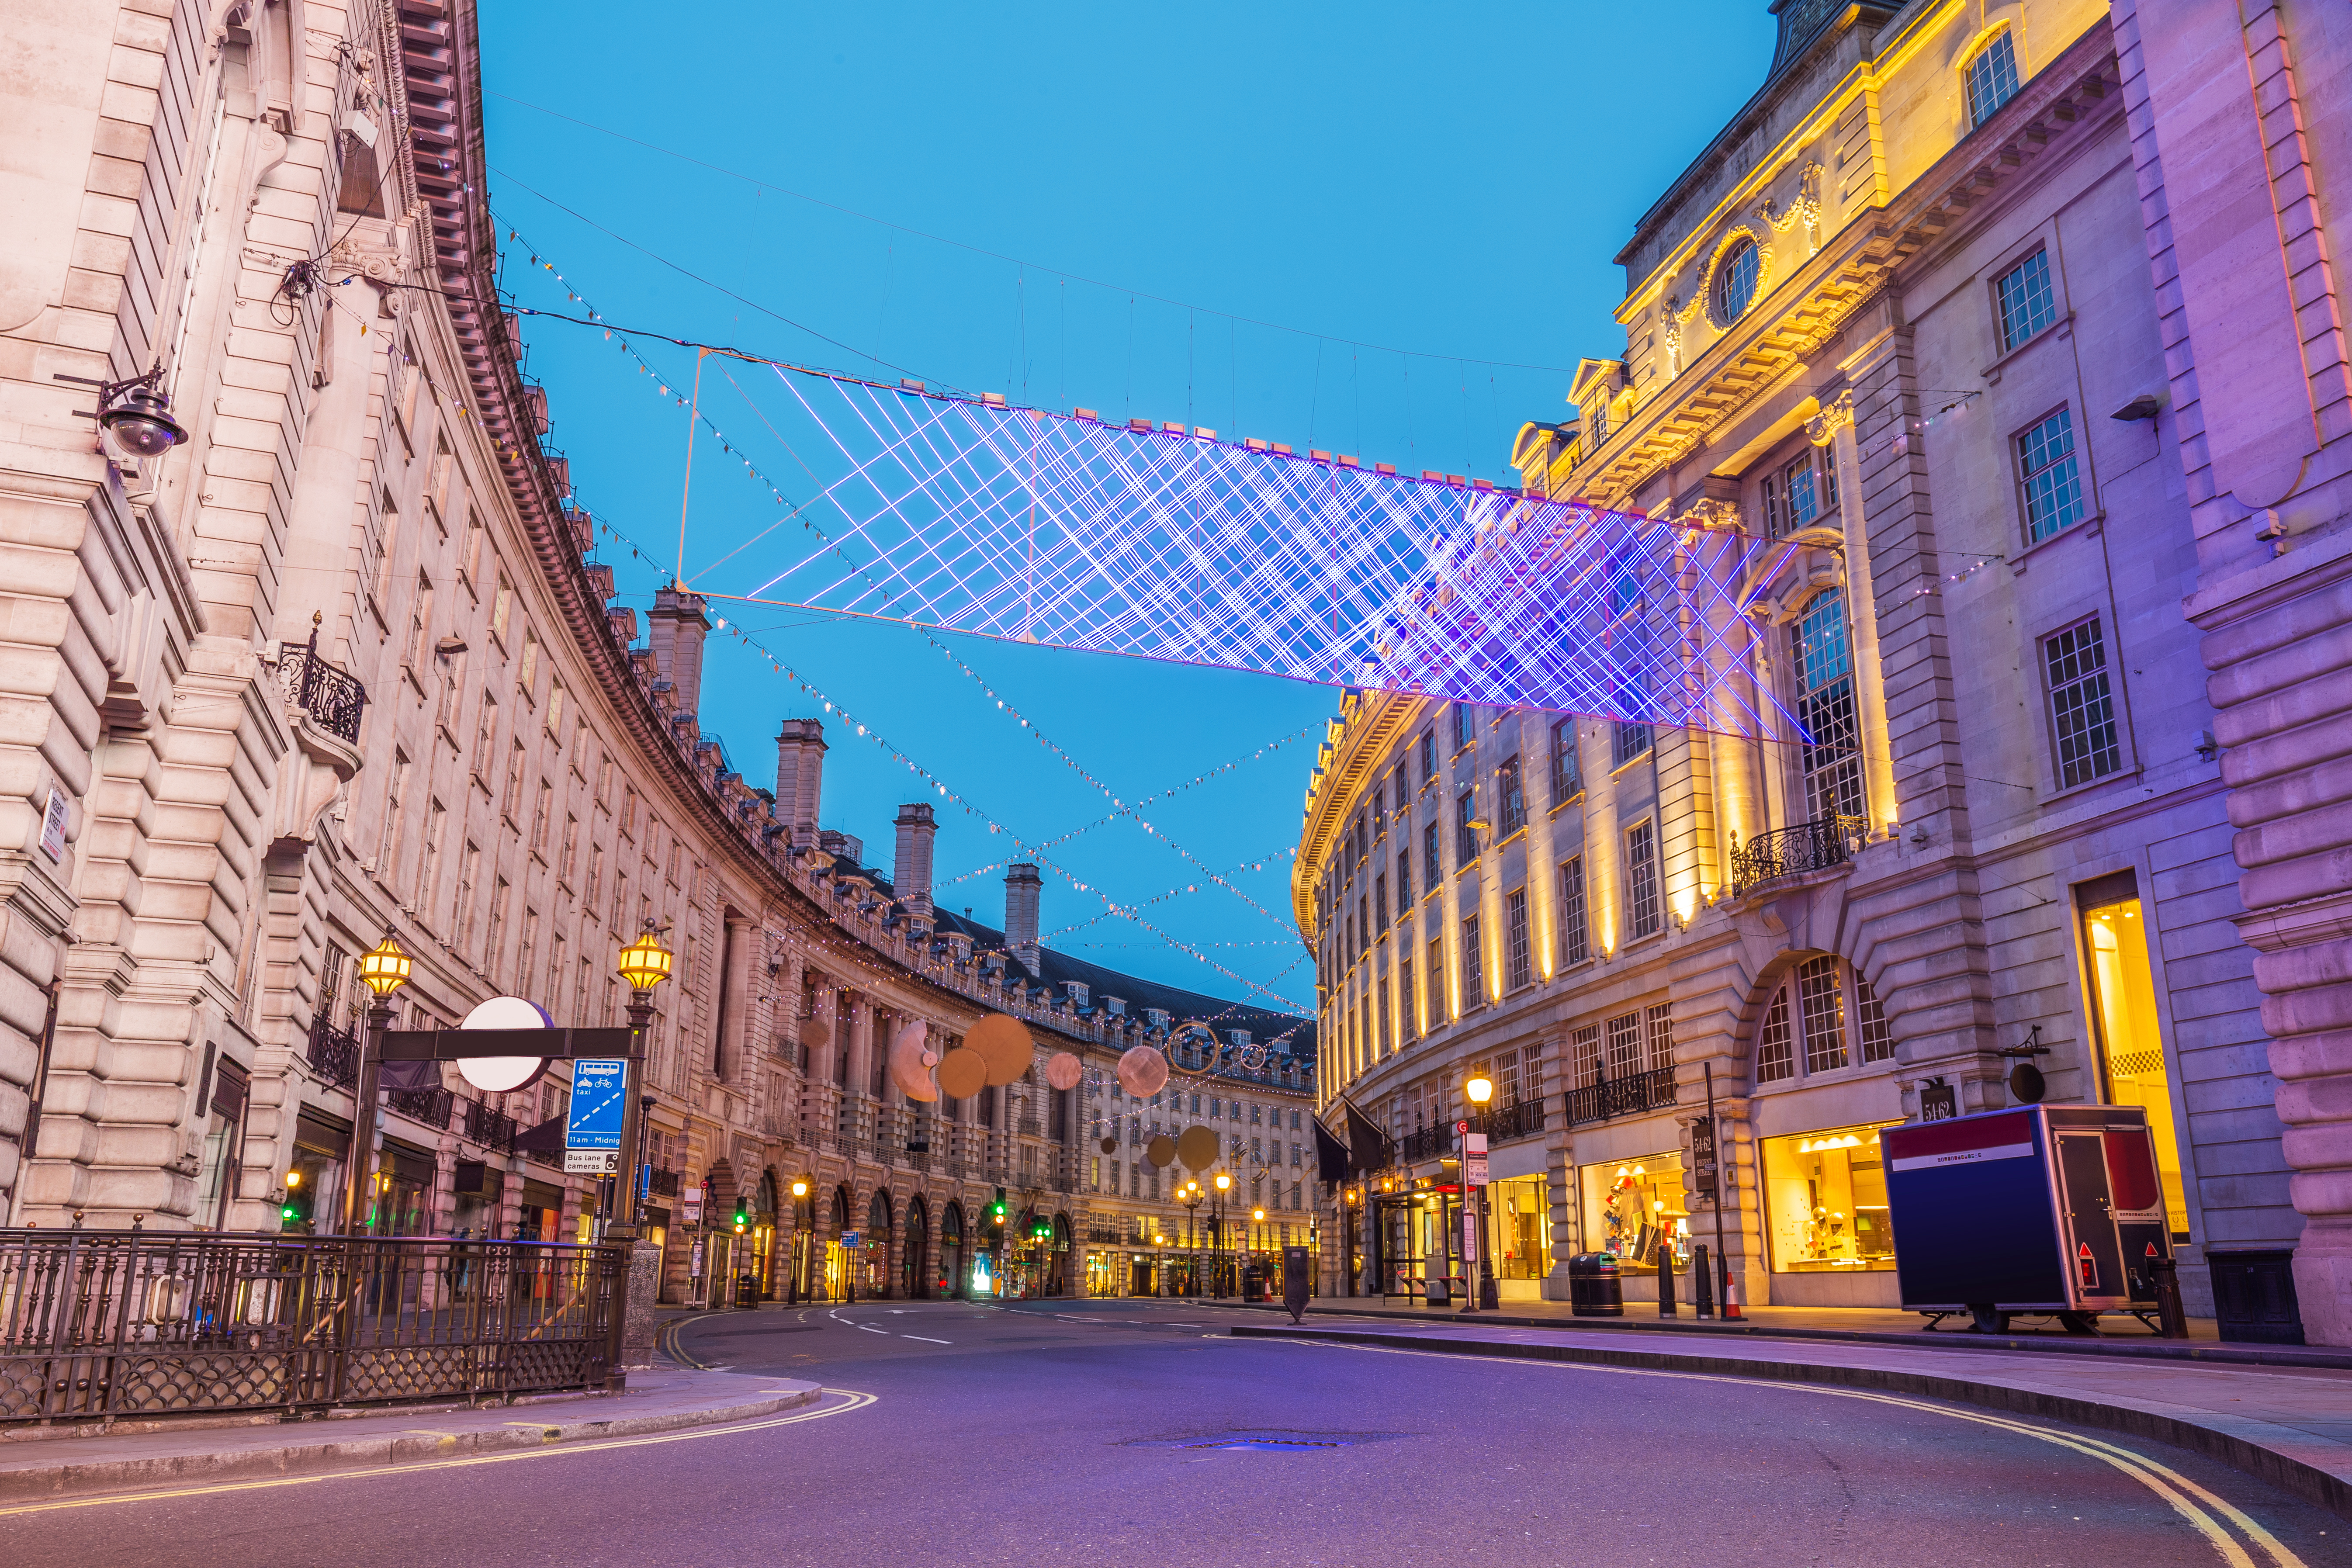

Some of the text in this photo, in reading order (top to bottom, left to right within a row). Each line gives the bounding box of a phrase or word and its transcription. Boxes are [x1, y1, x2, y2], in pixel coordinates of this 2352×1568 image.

[51, 796, 64, 818] REGENT
[48, 811, 60, 832] STREET
[59, 823, 65, 838] W1
[1925, 1101, 1950, 1121] 54-62
[1459, 1122, 1466, 1132] G
[1694, 1136, 1711, 1153] 54-62
[1696, 1158, 1712, 1167] REGENT
